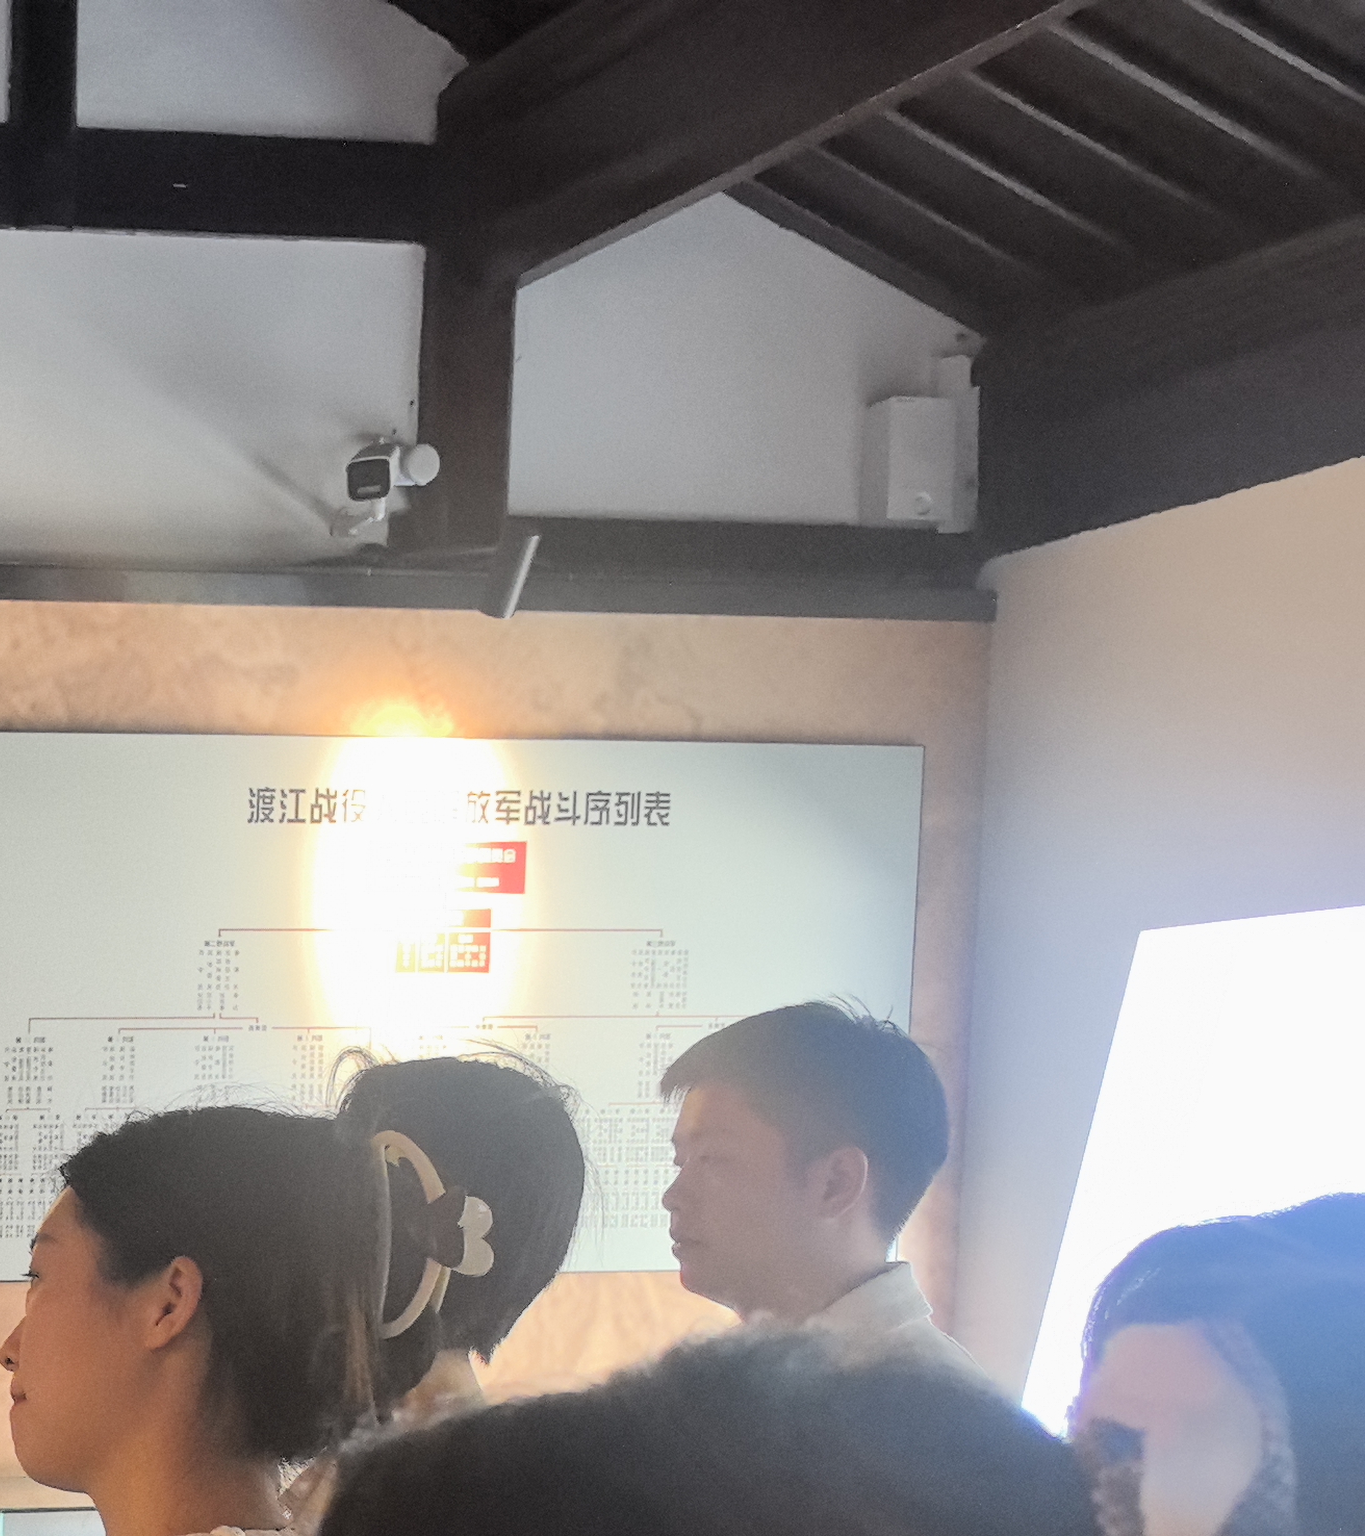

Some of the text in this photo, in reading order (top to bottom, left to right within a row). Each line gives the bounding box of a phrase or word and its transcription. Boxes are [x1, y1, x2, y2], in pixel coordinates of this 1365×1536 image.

[247, 786, 672, 828] 渡江战役放军战斗序列表
